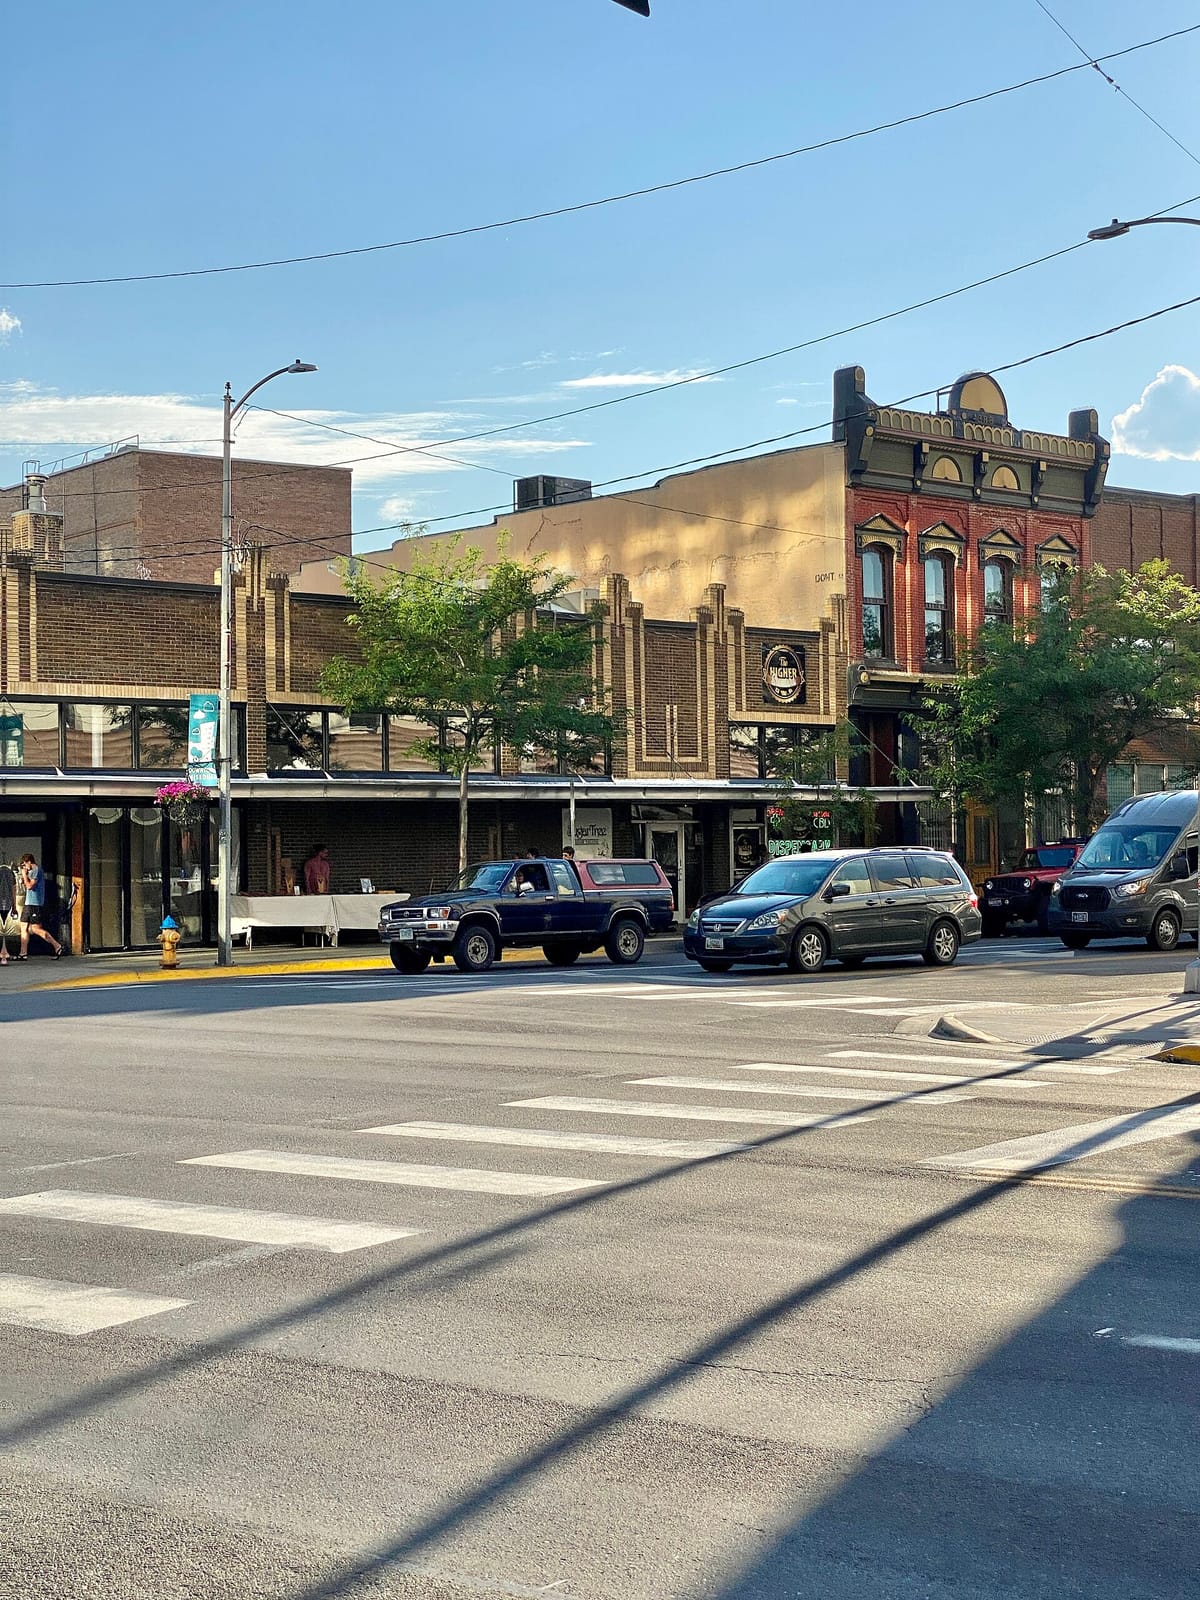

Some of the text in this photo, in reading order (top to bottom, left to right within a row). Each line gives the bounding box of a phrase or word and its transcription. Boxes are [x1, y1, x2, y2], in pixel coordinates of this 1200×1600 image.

[779, 656, 789, 667] The
[769, 666, 798, 680] HIGHER
[766, 807, 785, 817] OPEN
[813, 817, 831, 829] CBD
